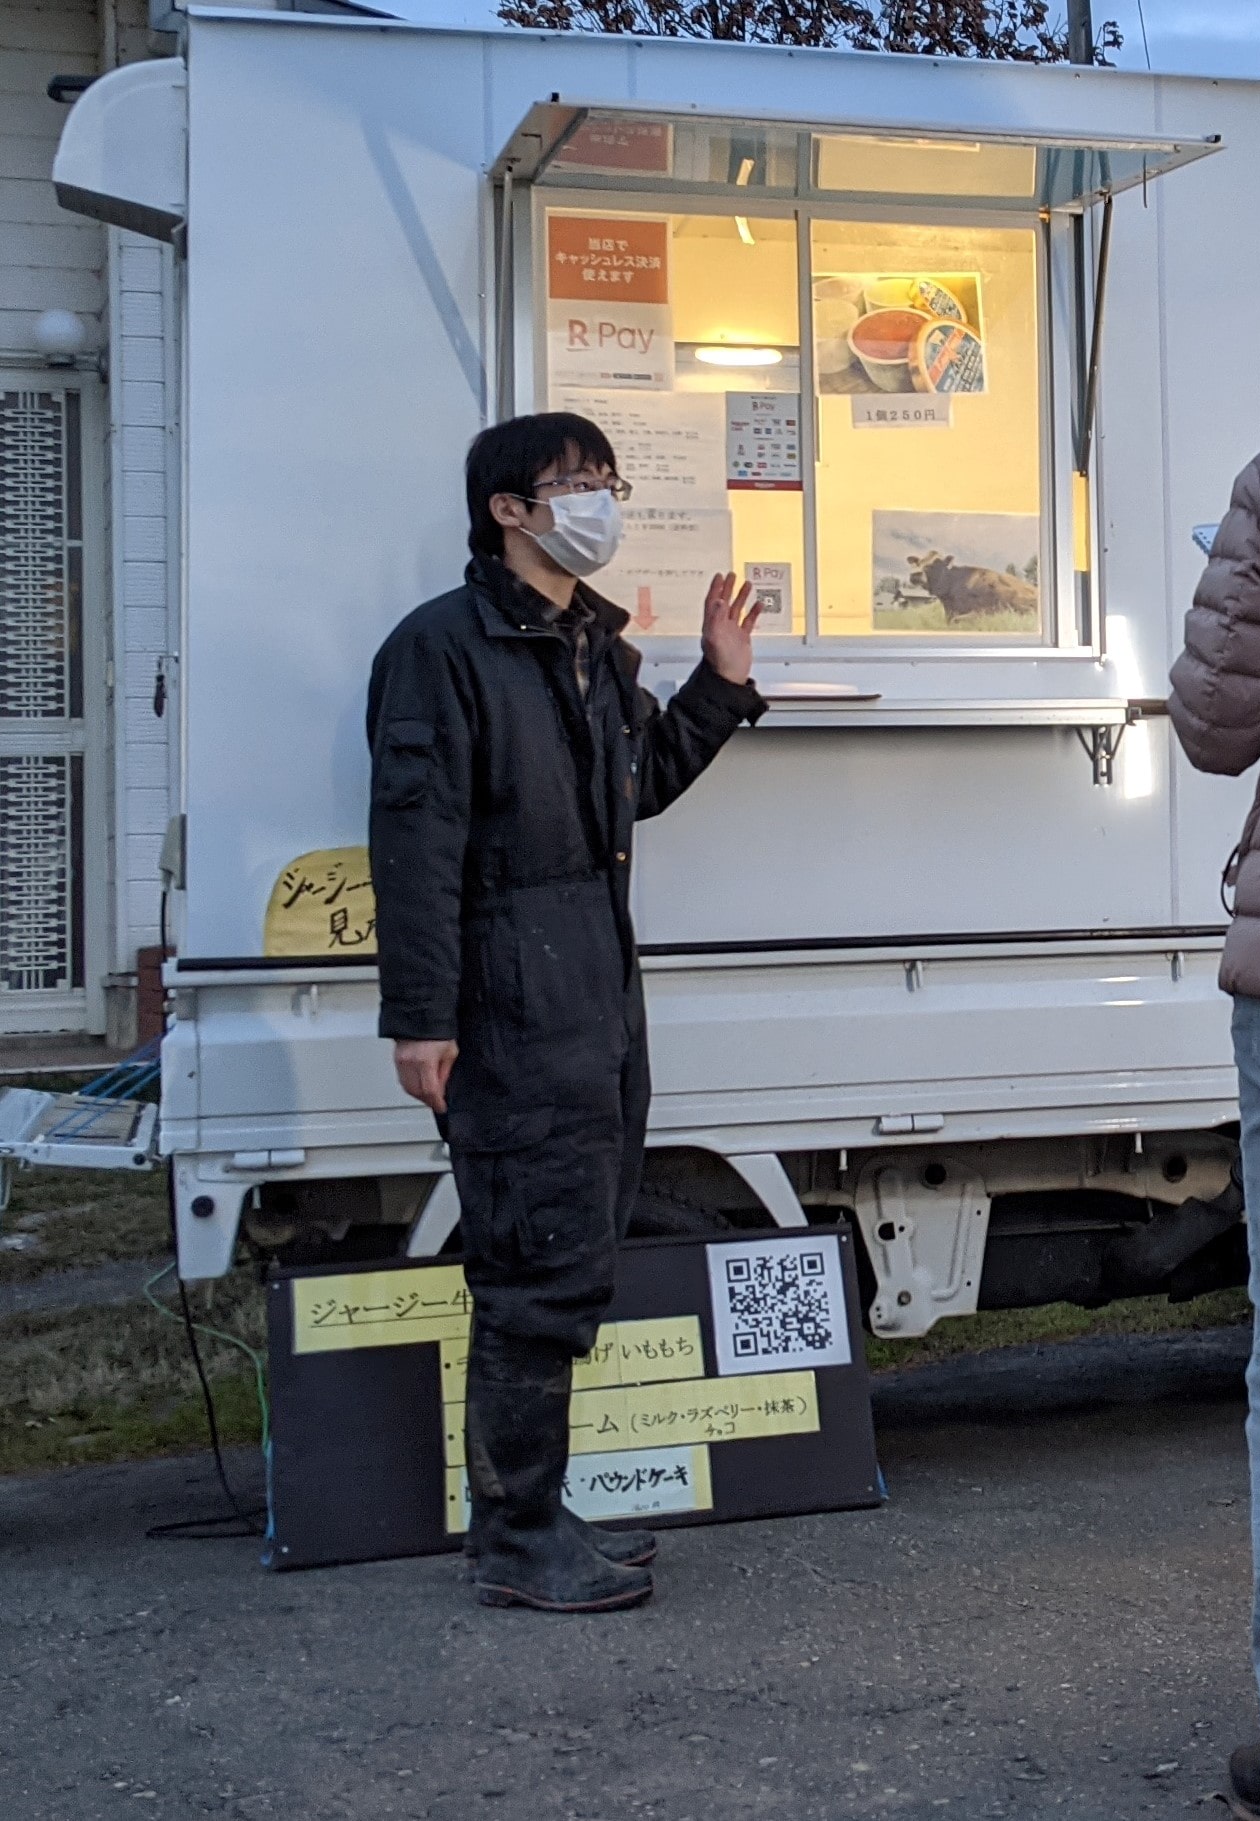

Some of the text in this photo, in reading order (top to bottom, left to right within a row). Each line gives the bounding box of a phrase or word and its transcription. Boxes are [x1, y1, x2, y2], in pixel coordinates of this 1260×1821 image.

[588, 237, 629, 251] 当店で
[555, 252, 661, 268] キャッシュレス決済
[582, 268, 635, 284] 使えます
[567, 319, 655, 354] R Pay
